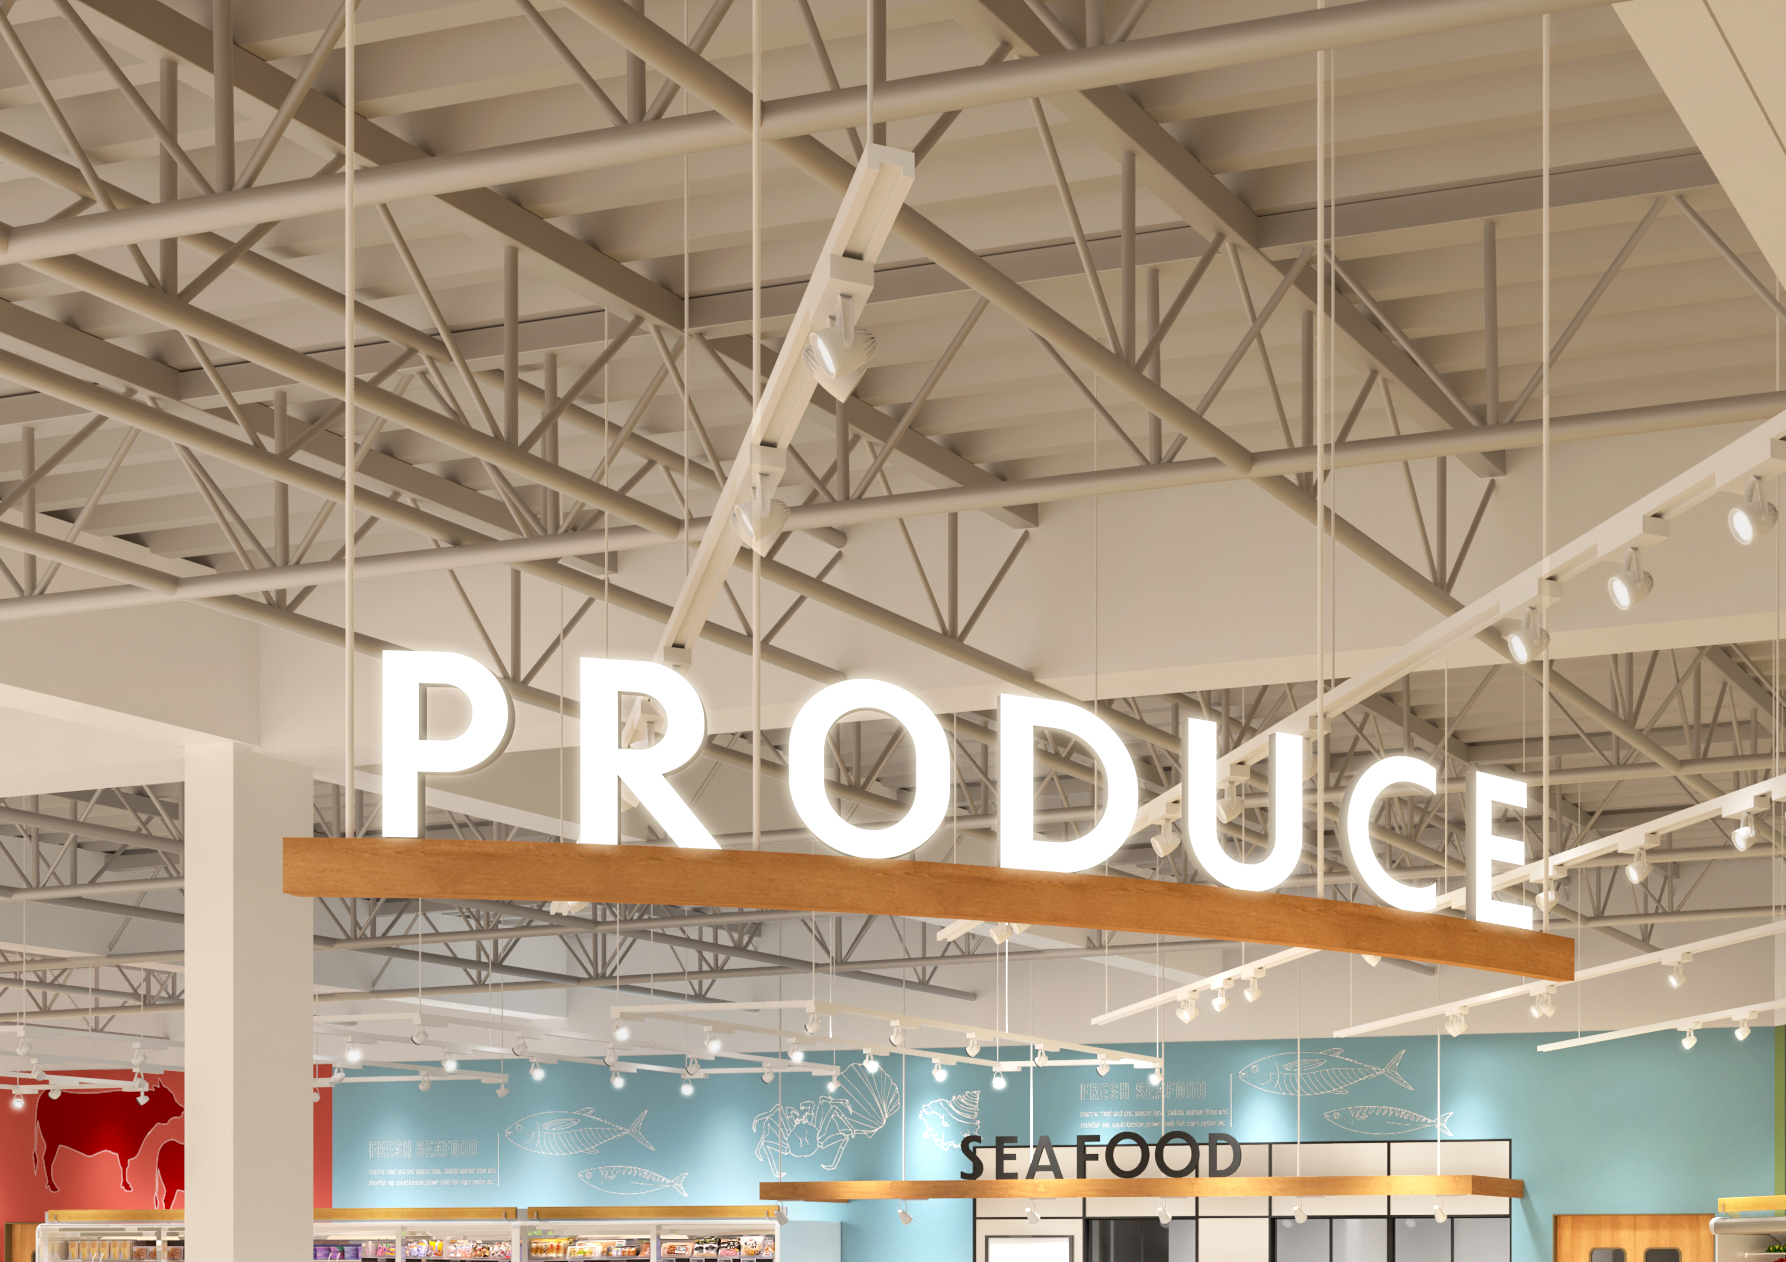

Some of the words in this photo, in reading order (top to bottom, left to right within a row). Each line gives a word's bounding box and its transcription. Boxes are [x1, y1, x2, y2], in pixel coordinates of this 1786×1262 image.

[381, 649, 1535, 931] PRODUCE
[1080, 1082, 1129, 1101] FRESH
[1136, 1081, 1207, 1100] SEAFOOD
[369, 1140, 412, 1159] FRESH
[416, 1139, 478, 1158] SEAFOOD
[960, 1131, 1242, 1181] SEAFOOD
